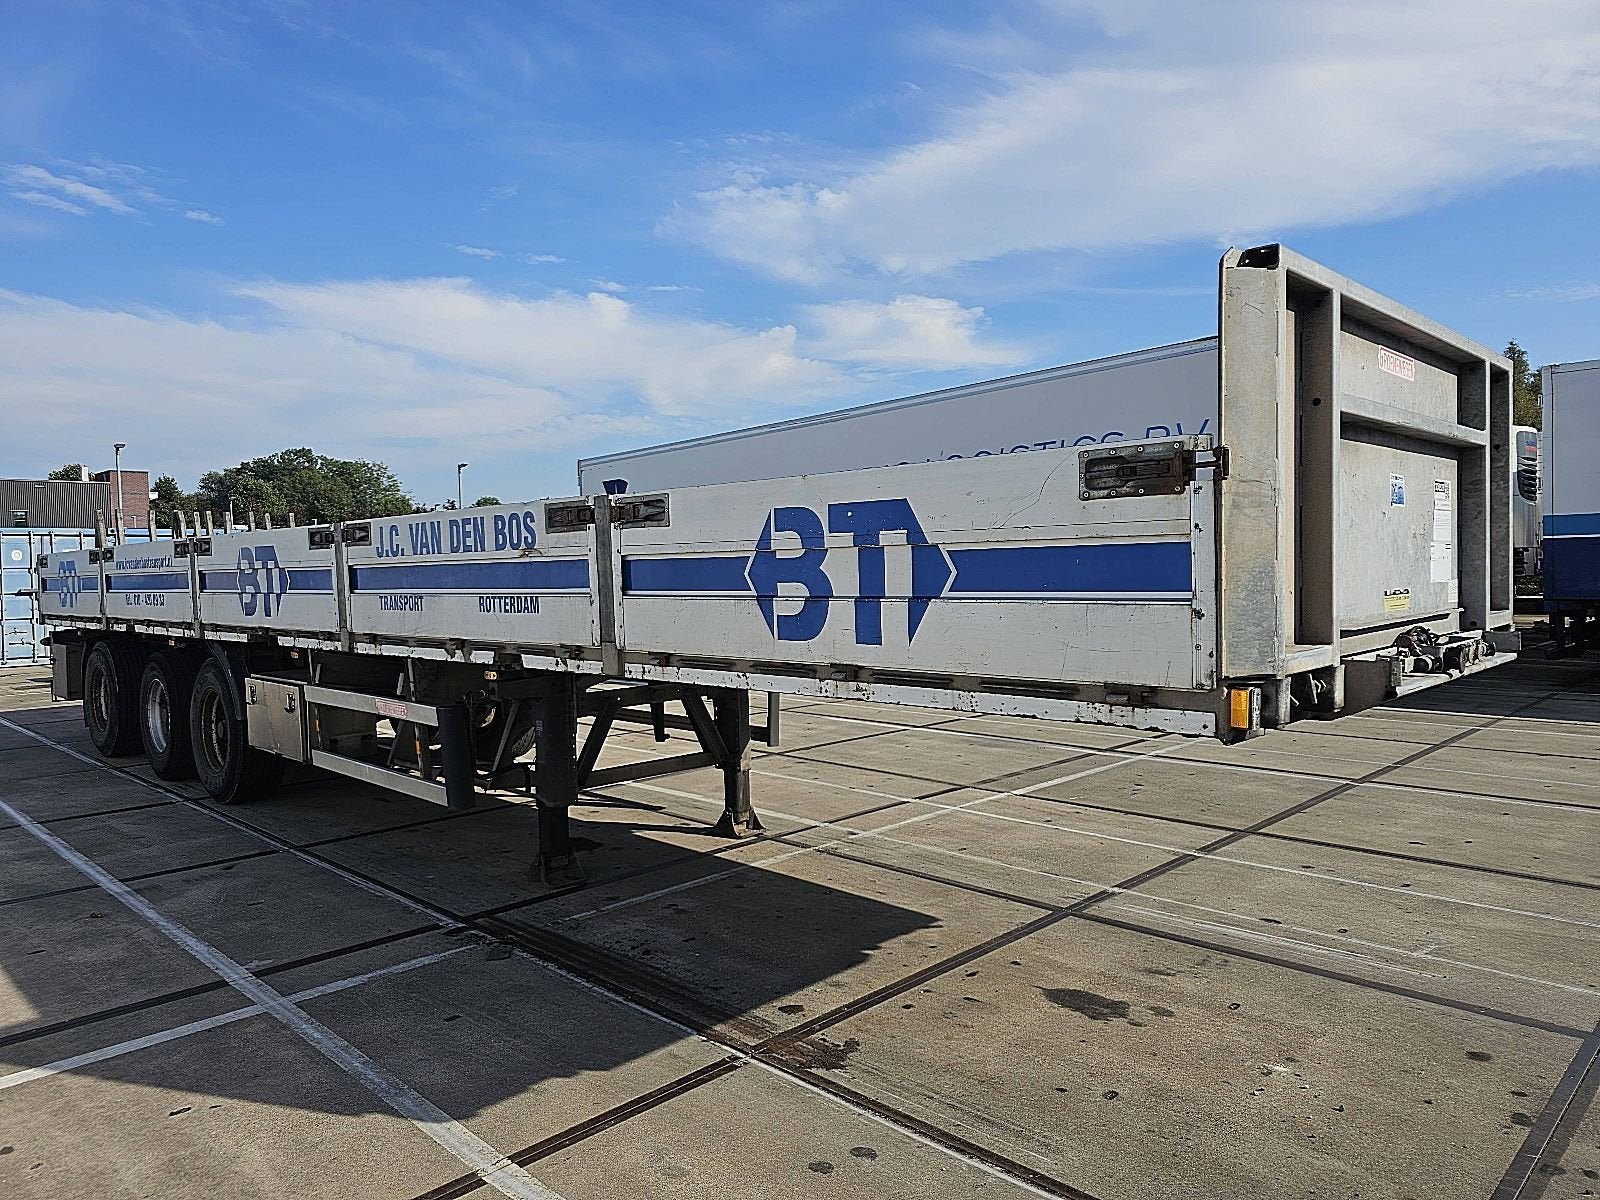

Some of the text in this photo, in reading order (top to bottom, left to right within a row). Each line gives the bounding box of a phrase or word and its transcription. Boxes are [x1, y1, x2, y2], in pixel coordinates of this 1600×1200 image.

[376, 510, 537, 558] J.C. VAN DEN BOS
[379, 595, 540, 614] TRANSPORT ROTTERDAM
